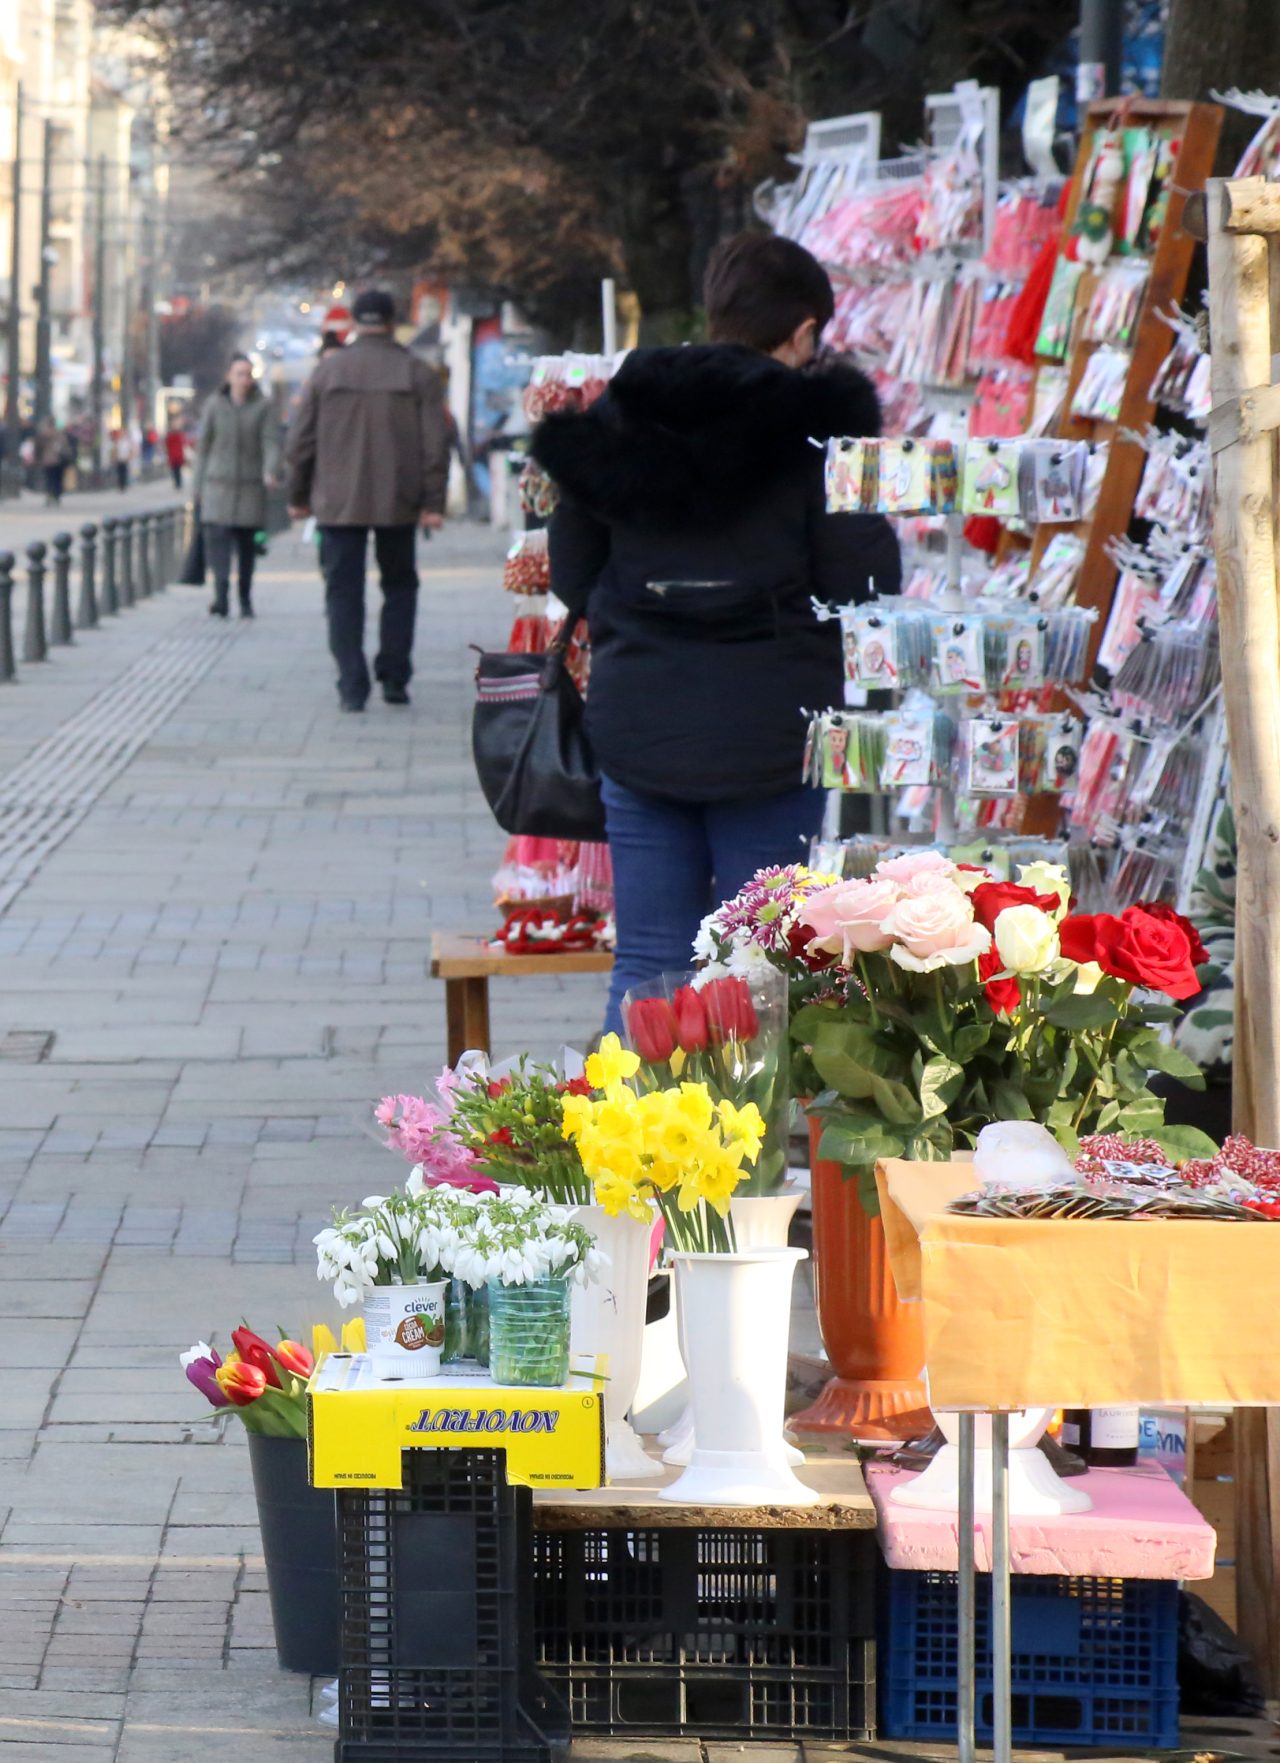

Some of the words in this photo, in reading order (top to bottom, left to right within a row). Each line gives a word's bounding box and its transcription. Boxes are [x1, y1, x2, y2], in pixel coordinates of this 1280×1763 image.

[404, 1302, 438, 1313] clever
[401, 1327, 425, 1344] CREAM
[410, 1408, 560, 1433] NOVOFRUT
